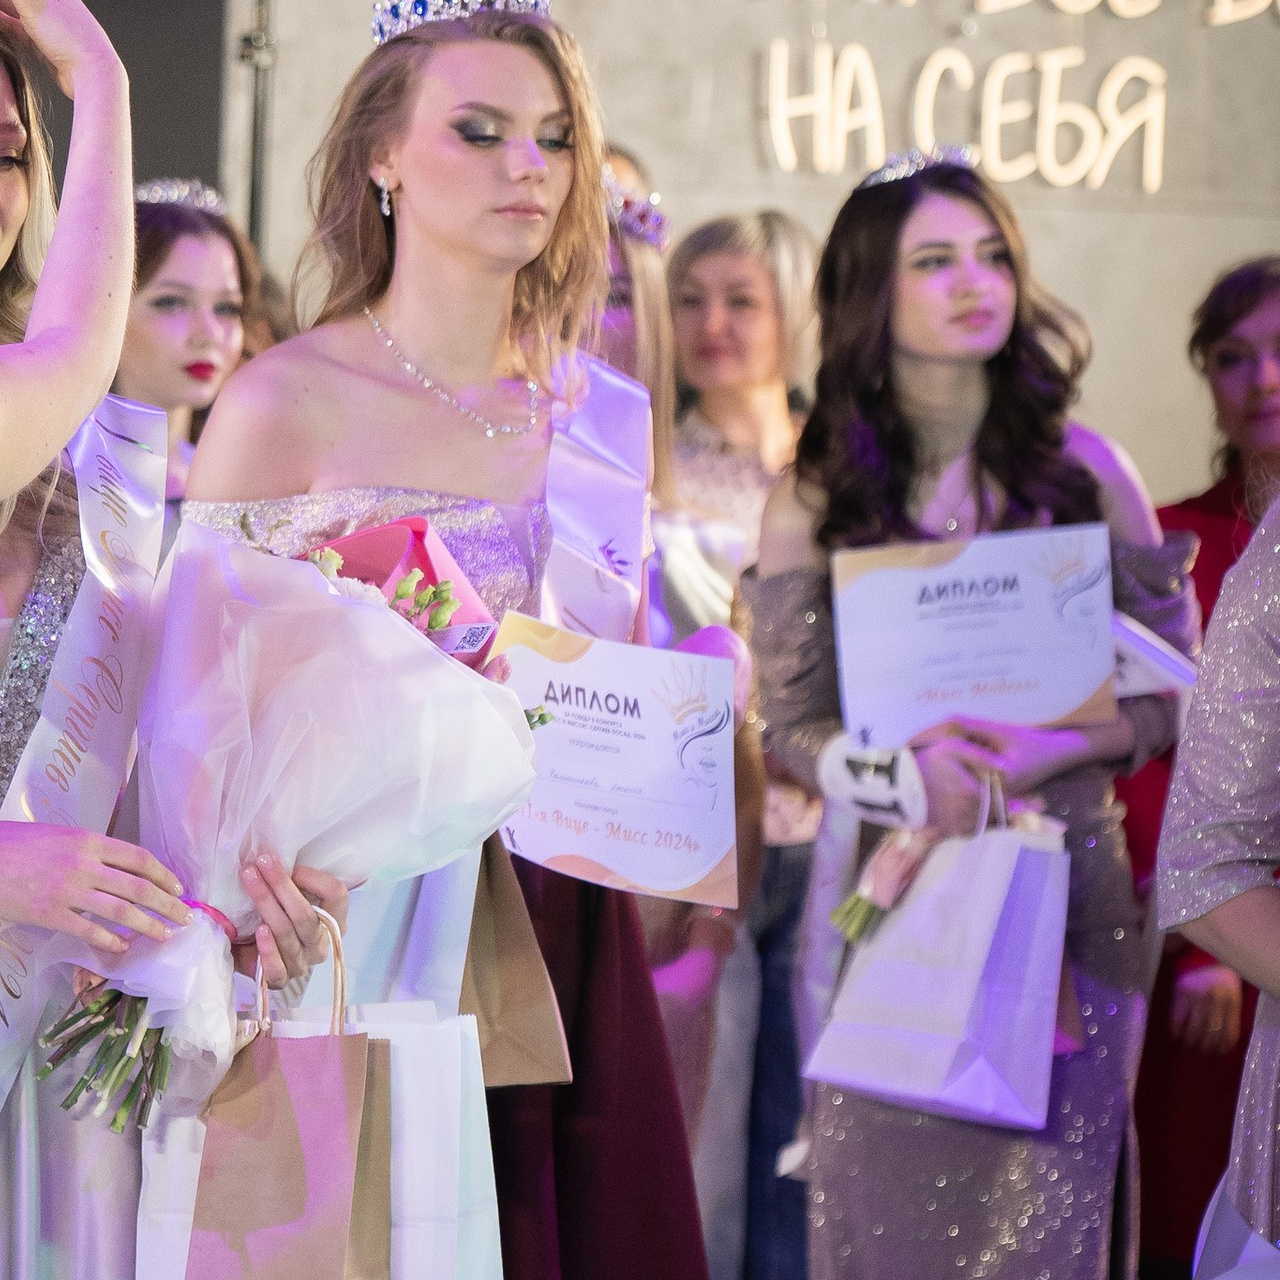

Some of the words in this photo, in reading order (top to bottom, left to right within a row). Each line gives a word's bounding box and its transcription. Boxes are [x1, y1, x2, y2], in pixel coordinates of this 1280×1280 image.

[769, 37, 886, 175] НА
[914, 46, 1168, 194] СЕБЯ
[918, 574, 1020, 606] ДИПЛОМ
[544, 680, 641, 719] ДИПЛОМ
[45, 654, 124, 792] Сергиев
[552, 809, 588, 836] Вице
[605, 821, 648, 846] Мисс
